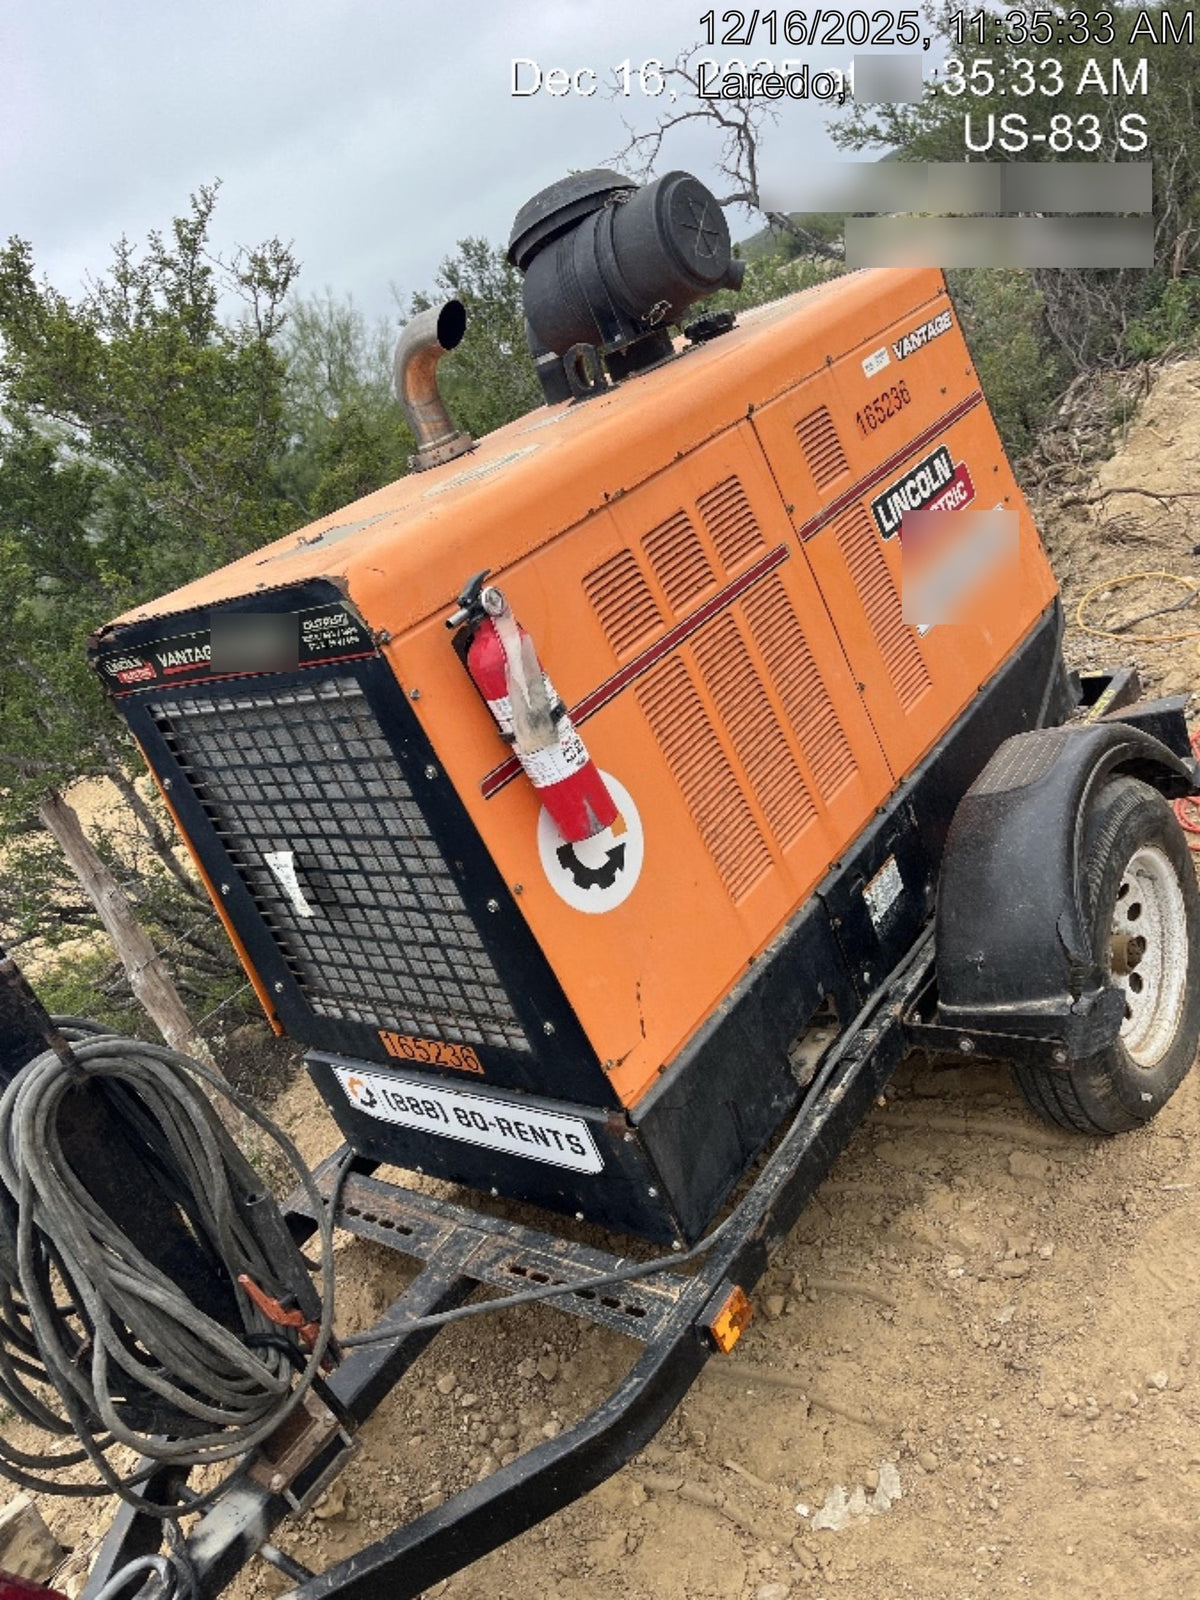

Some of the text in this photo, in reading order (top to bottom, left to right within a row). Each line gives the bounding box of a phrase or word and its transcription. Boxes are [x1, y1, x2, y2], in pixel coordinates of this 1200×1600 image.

[892, 309, 953, 361] VANTAGE
[856, 379, 912, 436] 165236
[876, 452, 953, 533] LINCOLN
[156, 644, 211, 668] VANTAG
[384, 1031, 478, 1071] 165236
[382, 1089, 587, 1156] (888) 80-RENTS
